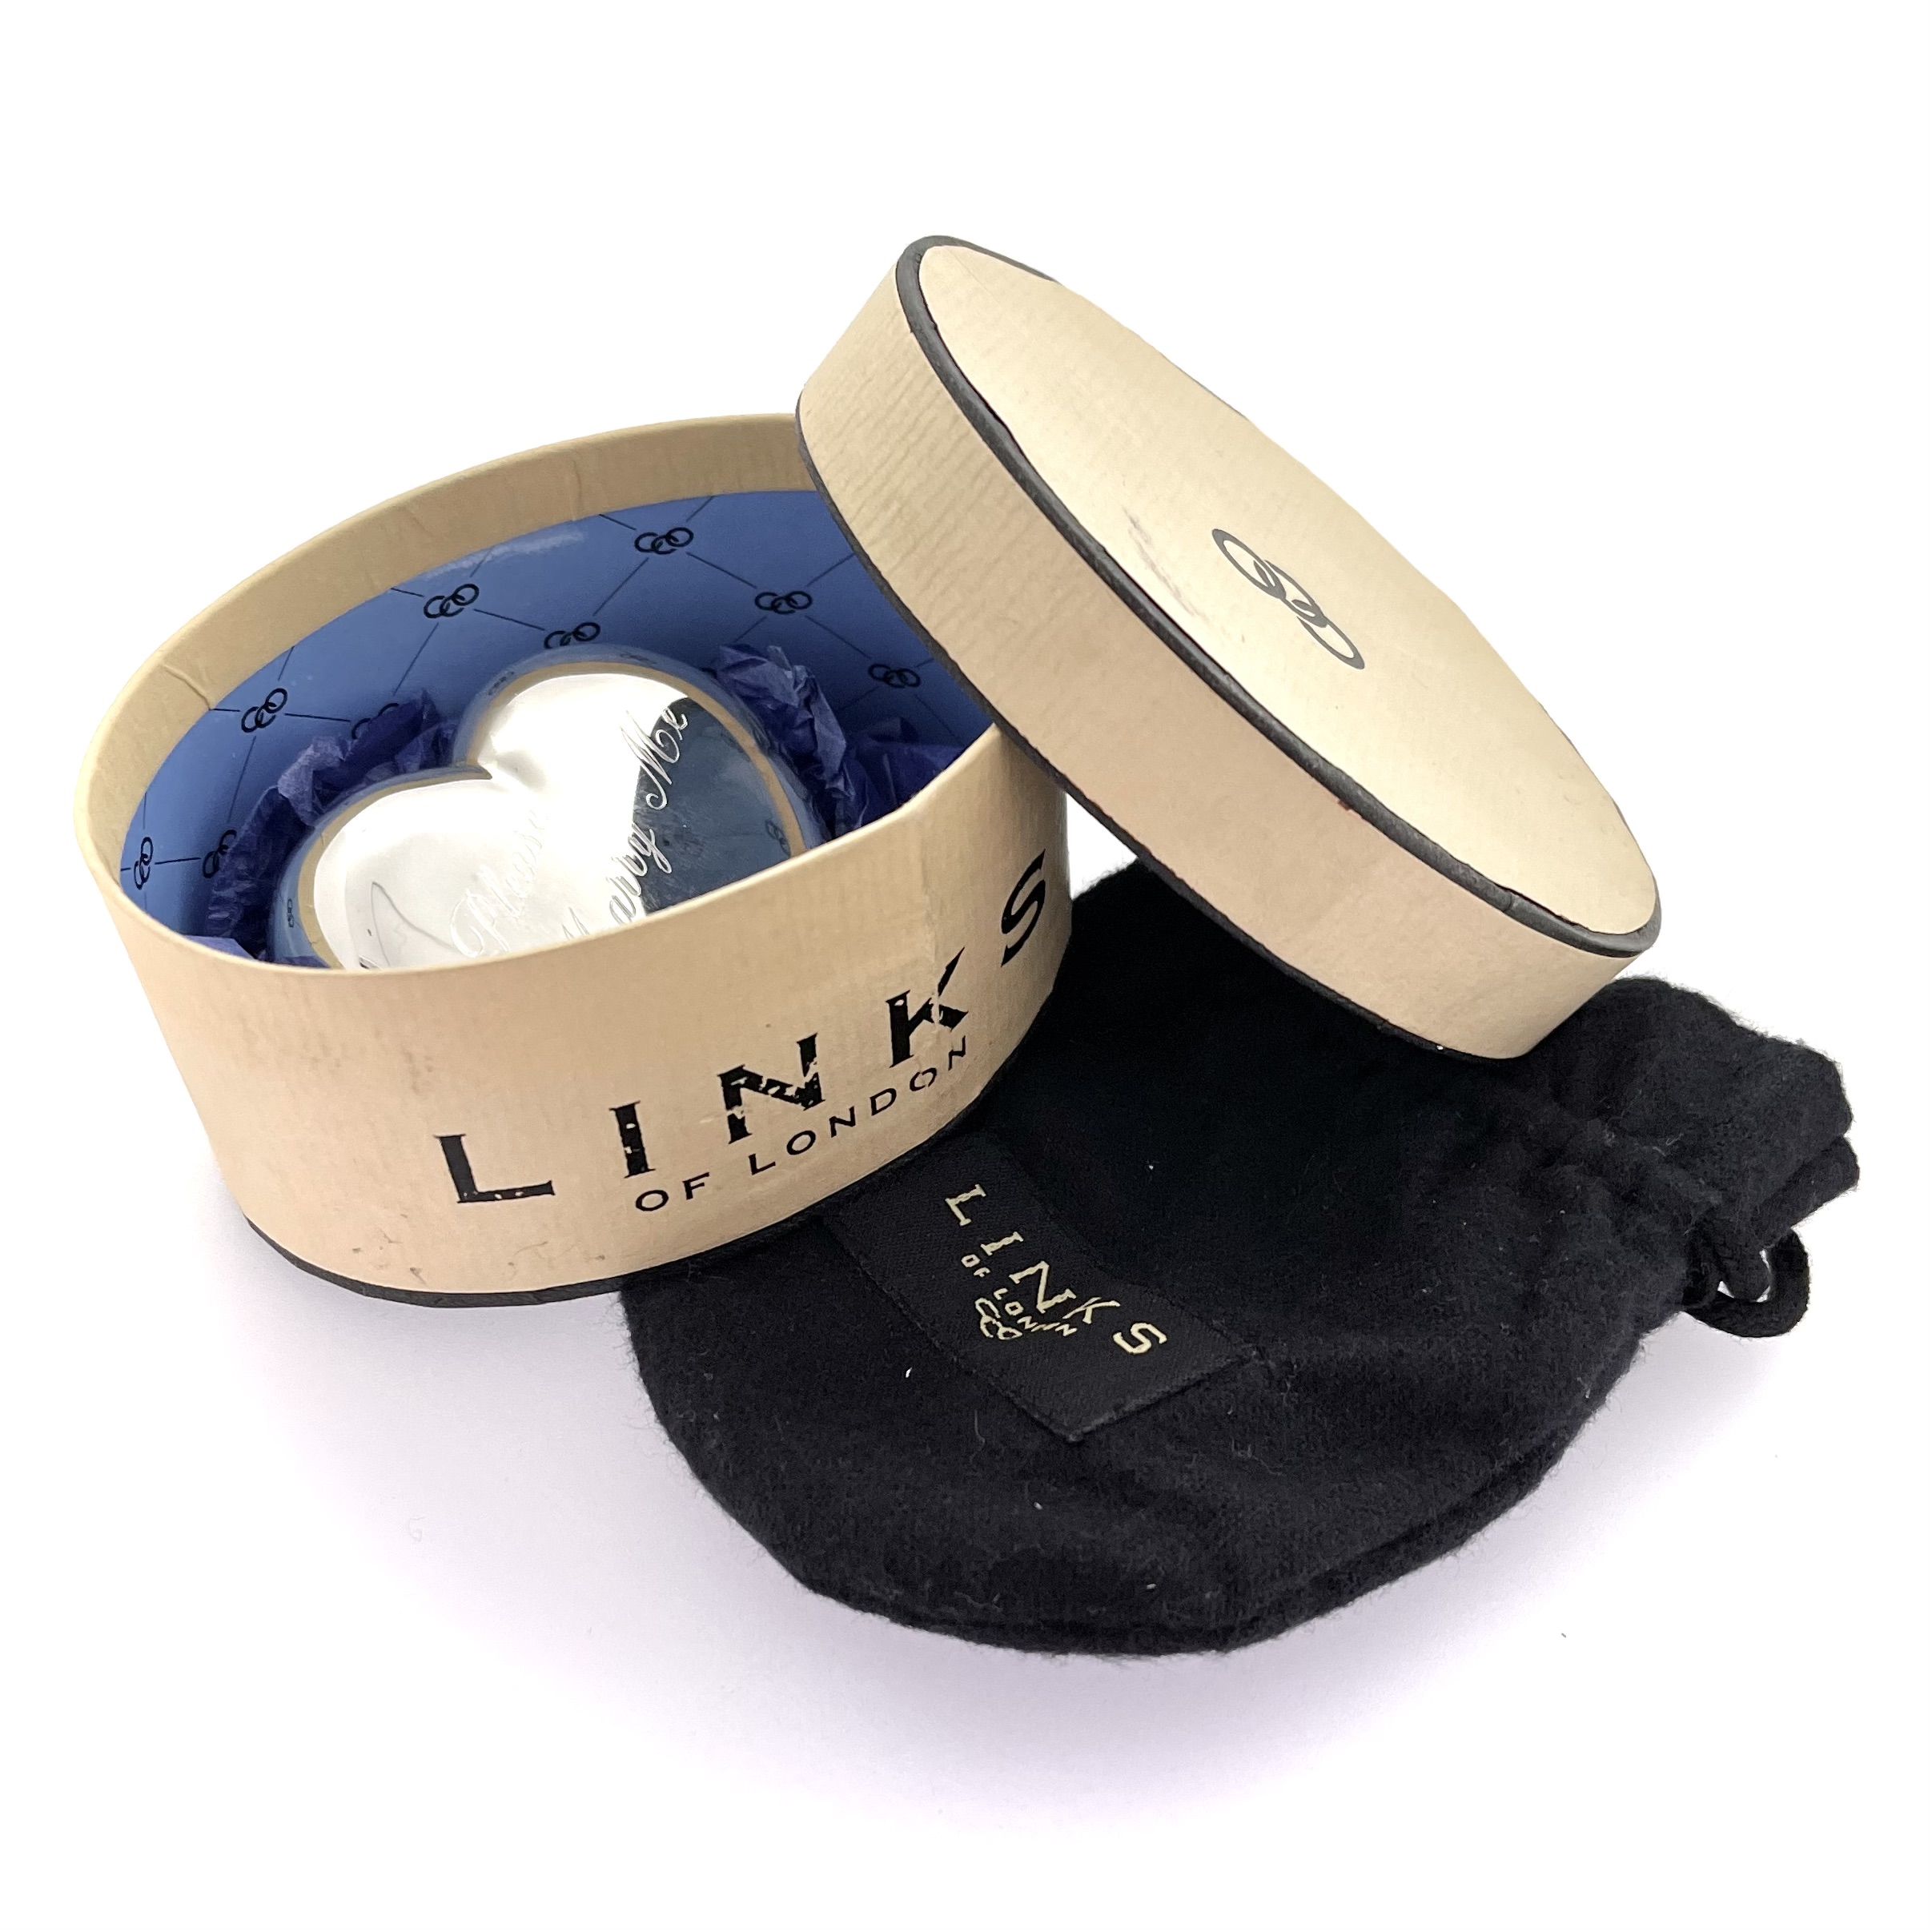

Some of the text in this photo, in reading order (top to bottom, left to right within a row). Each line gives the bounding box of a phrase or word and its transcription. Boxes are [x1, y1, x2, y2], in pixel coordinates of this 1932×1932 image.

[620, 709, 689, 810] Me
[433, 849, 1047, 1204] LINKS
[634, 1035, 969, 1212] OF LONDON
[946, 1184, 1168, 1355] LINKS
[961, 1253, 992, 1278] OF
